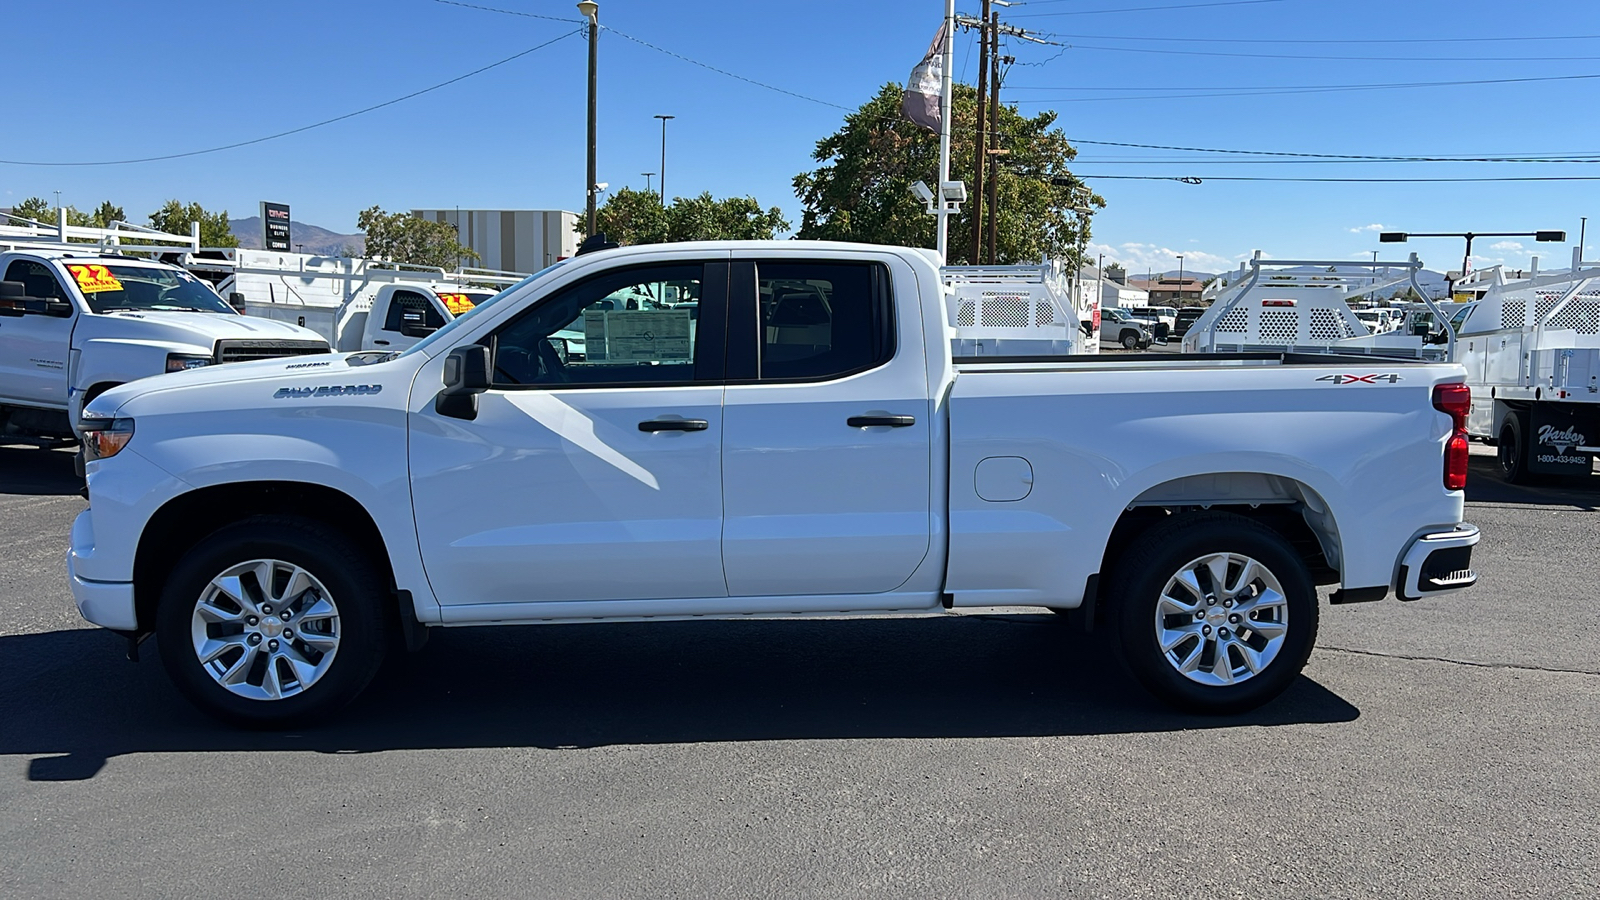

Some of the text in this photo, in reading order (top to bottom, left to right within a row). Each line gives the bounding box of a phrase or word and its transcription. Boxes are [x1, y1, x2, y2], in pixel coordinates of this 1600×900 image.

[268, 209, 289, 219] GMC
[70, 265, 115, 283] 22
[272, 384, 382, 399] SILVERADO
[1538, 424, 1586, 446] Harbor
[1537, 454, 1586, 464] 1-800-433-9452
